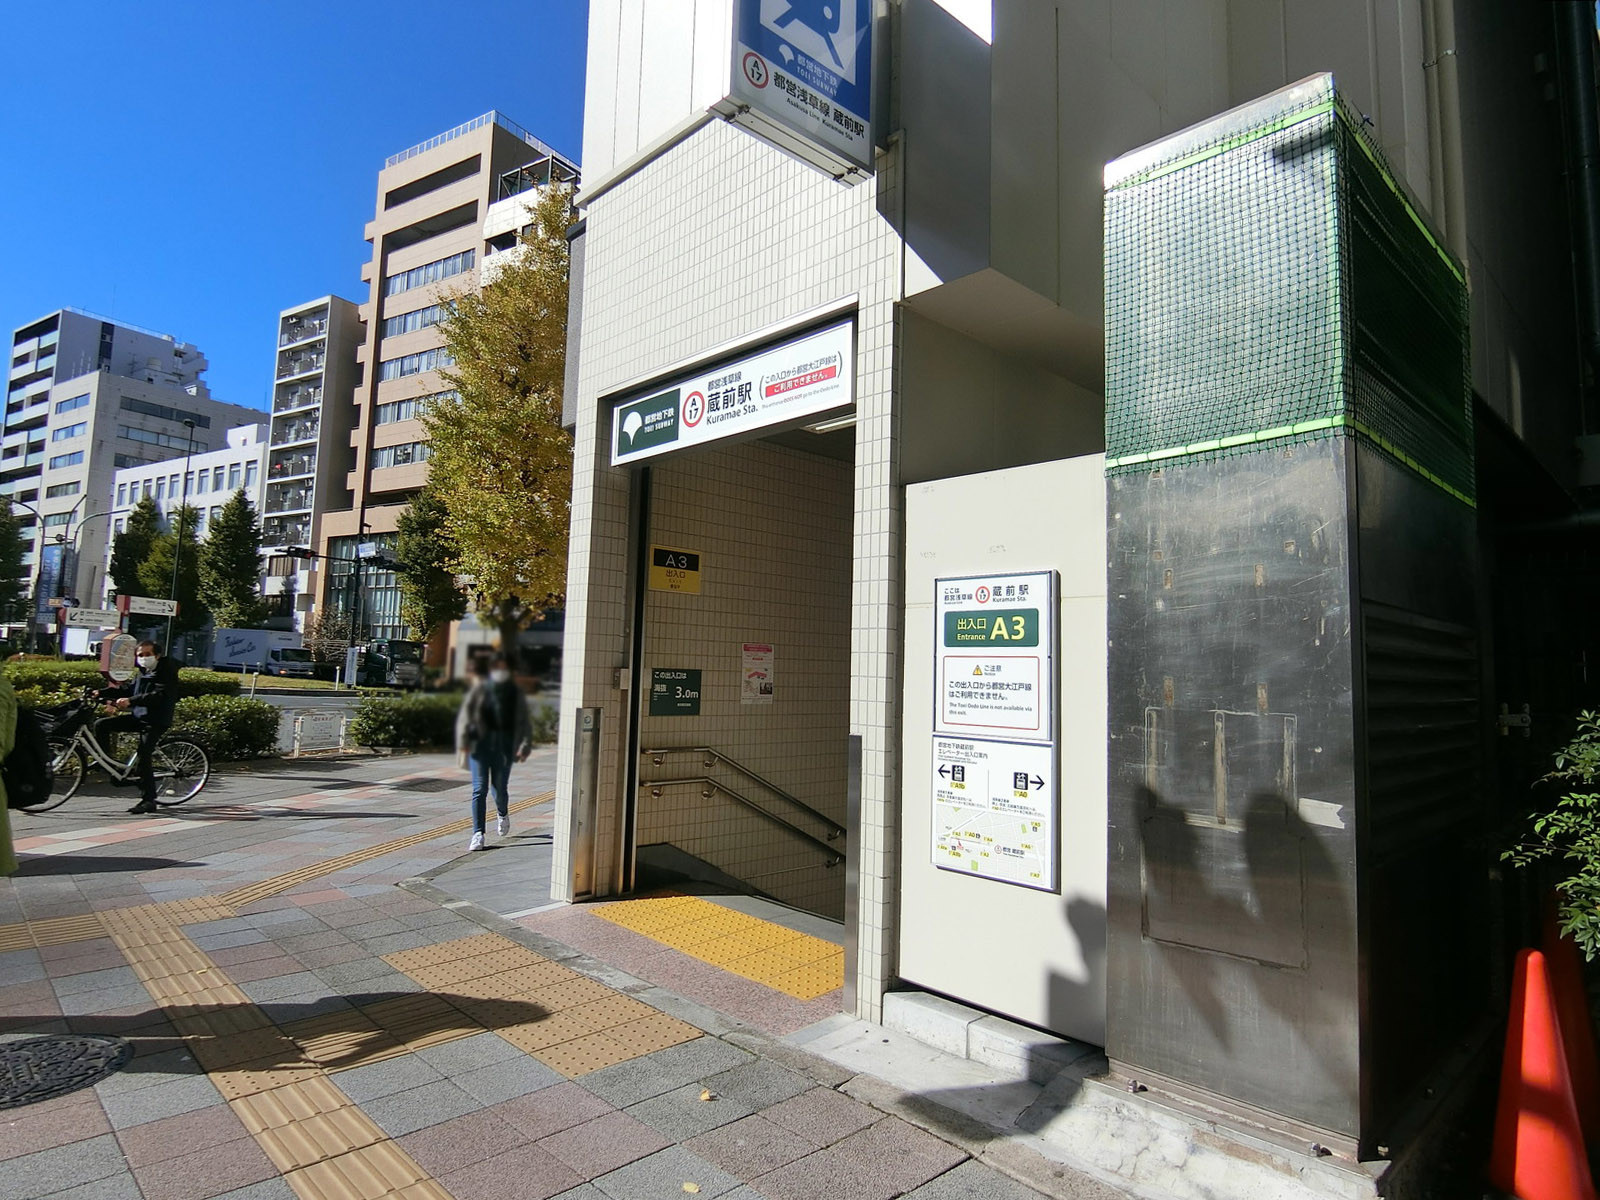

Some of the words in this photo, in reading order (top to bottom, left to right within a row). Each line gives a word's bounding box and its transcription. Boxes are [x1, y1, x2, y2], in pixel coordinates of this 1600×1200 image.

[753, 60, 760, 71] A
[797, 54, 838, 87] 都営地下鉄
[751, 68, 763, 81] 17
[812, 78, 837, 97] SUBWAY
[774, 71, 830, 118] 都営浅草線
[833, 108, 865, 139] 蔵前駅
[708, 371, 742, 391] 都営浅草線
[691, 398, 697, 408] A
[707, 382, 752, 414] 蔵前駅
[645, 407, 674, 425] 都営地下鉄
[689, 408, 699, 420] 17
[706, 409, 740, 425] Kuramae
[743, 404, 758, 415] Sta.
[666, 554, 687, 569] A3
[666, 569, 686, 578] 出入口
[944, 593, 973, 601] 都営浅草線
[992, 584, 1029, 597] 蔵前駅
[957, 618, 987, 630] 出入口
[990, 616, 1025, 640] A3
[675, 686, 699, 698] 3.0m
[949, 681, 1032, 691] この出入口から都営大江戸線
[949, 691, 1008, 701] はご利用できません。
